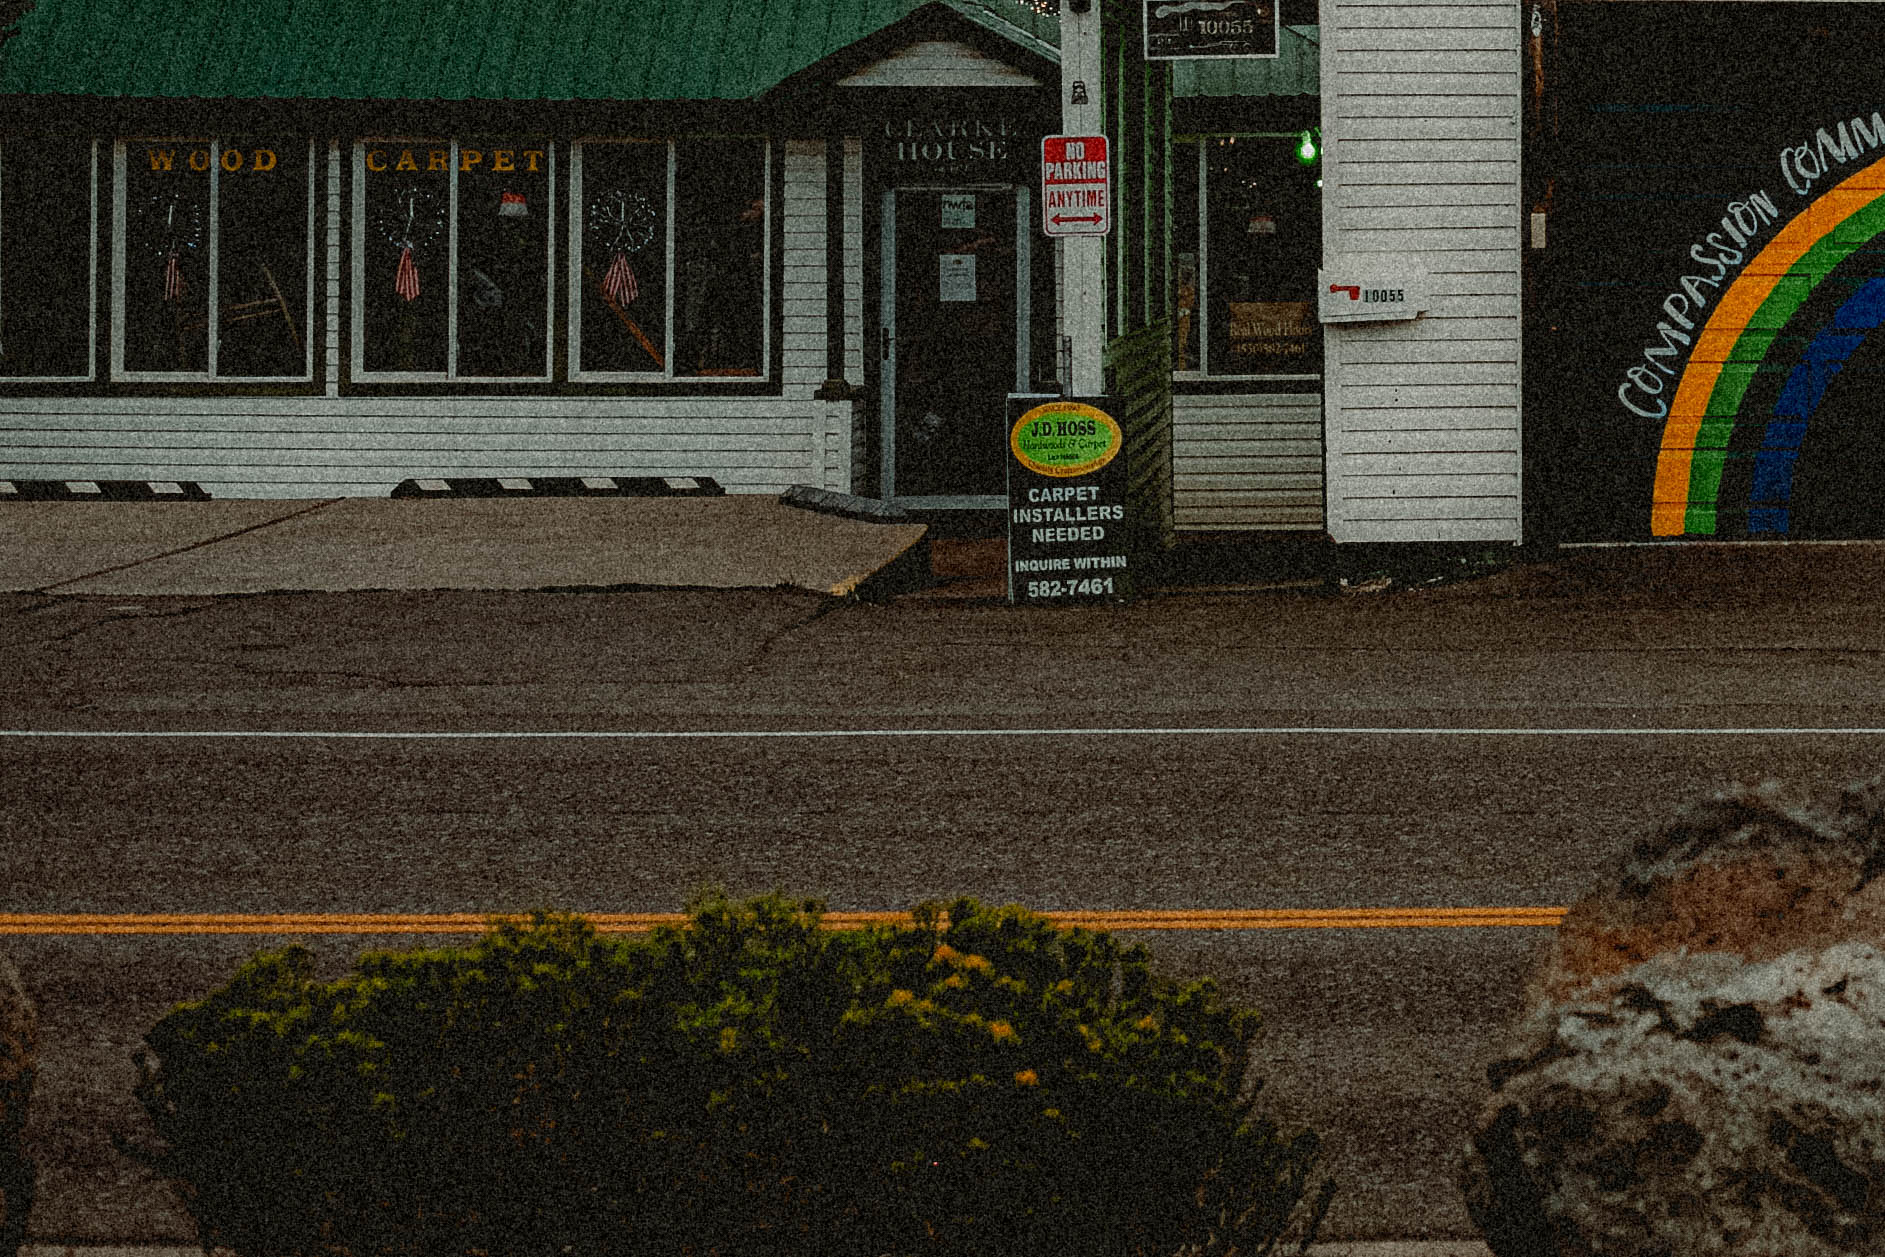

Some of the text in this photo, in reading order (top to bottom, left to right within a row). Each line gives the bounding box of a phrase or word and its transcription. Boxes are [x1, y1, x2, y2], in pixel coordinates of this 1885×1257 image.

[1198, 20, 1254, 35] 10055
[1064, 142, 1085, 161] NO
[149, 149, 280, 173] WOOD
[366, 149, 545, 173] CARPET
[1045, 161, 1105, 181] PARKING
[1049, 190, 1104, 208] ANYTIME
[1363, 289, 1404, 303] 10055
[1617, 190, 1780, 421] COMPASSION
[1057, 420, 1096, 437] HOSS
[1028, 486, 1100, 503] CARPET
[1013, 505, 1124, 524] INSTALLERS
[1031, 526, 1105, 543] NEEDED
[1015, 555, 1127, 573] INQUIRE WITHIN
[1028, 577, 1113, 598] 582-7461
